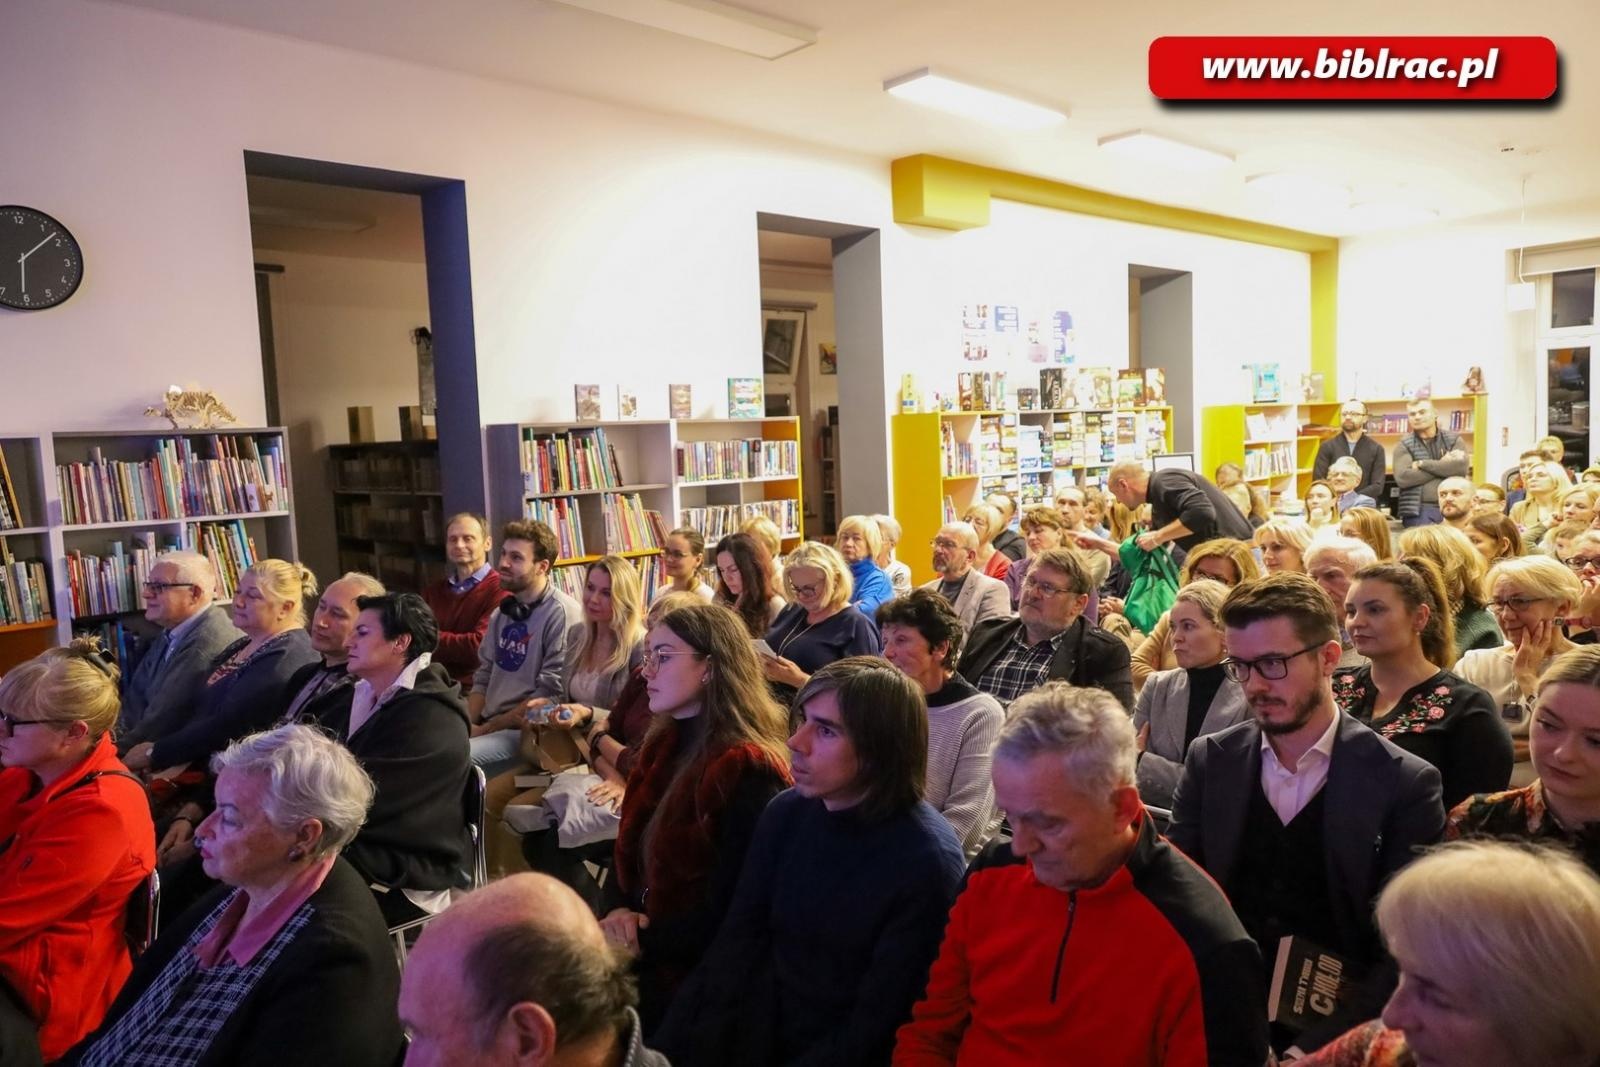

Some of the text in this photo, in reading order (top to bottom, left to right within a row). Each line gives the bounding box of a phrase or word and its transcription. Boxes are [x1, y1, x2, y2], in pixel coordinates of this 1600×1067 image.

[13, 215, 24, 224] 12
[40, 224, 45, 232] 1
[55, 238, 61, 247] 2
[64, 258, 71, 267] 3
[61, 275, 67, 284] 4
[45, 288, 52, 298] 5
[23, 294, 30, 303] 6
[499, 637, 526, 655] NASA
